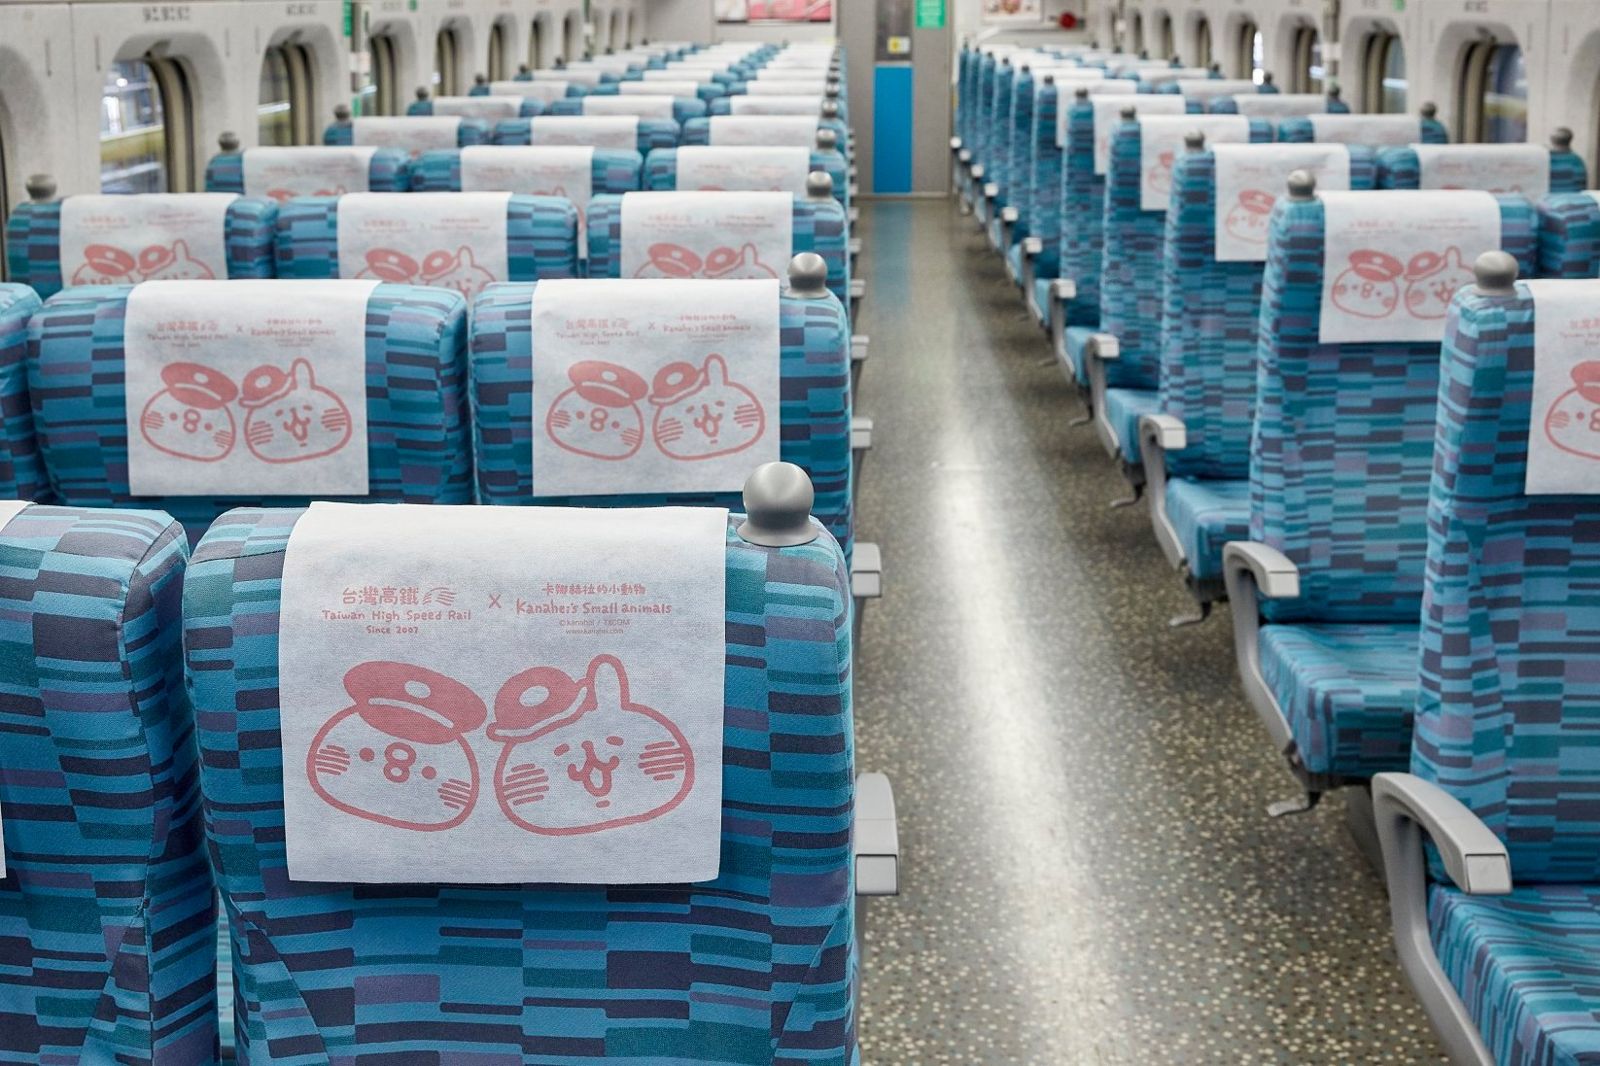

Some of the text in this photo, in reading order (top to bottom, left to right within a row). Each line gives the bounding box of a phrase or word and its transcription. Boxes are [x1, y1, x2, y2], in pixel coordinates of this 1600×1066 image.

[342, 585, 420, 606] 台灣高鐵
[516, 598, 673, 615] Kanahei's Small animals
[322, 609, 472, 623] Taiwan High Speed Rail
[366, 624, 419, 634] Since 2007
